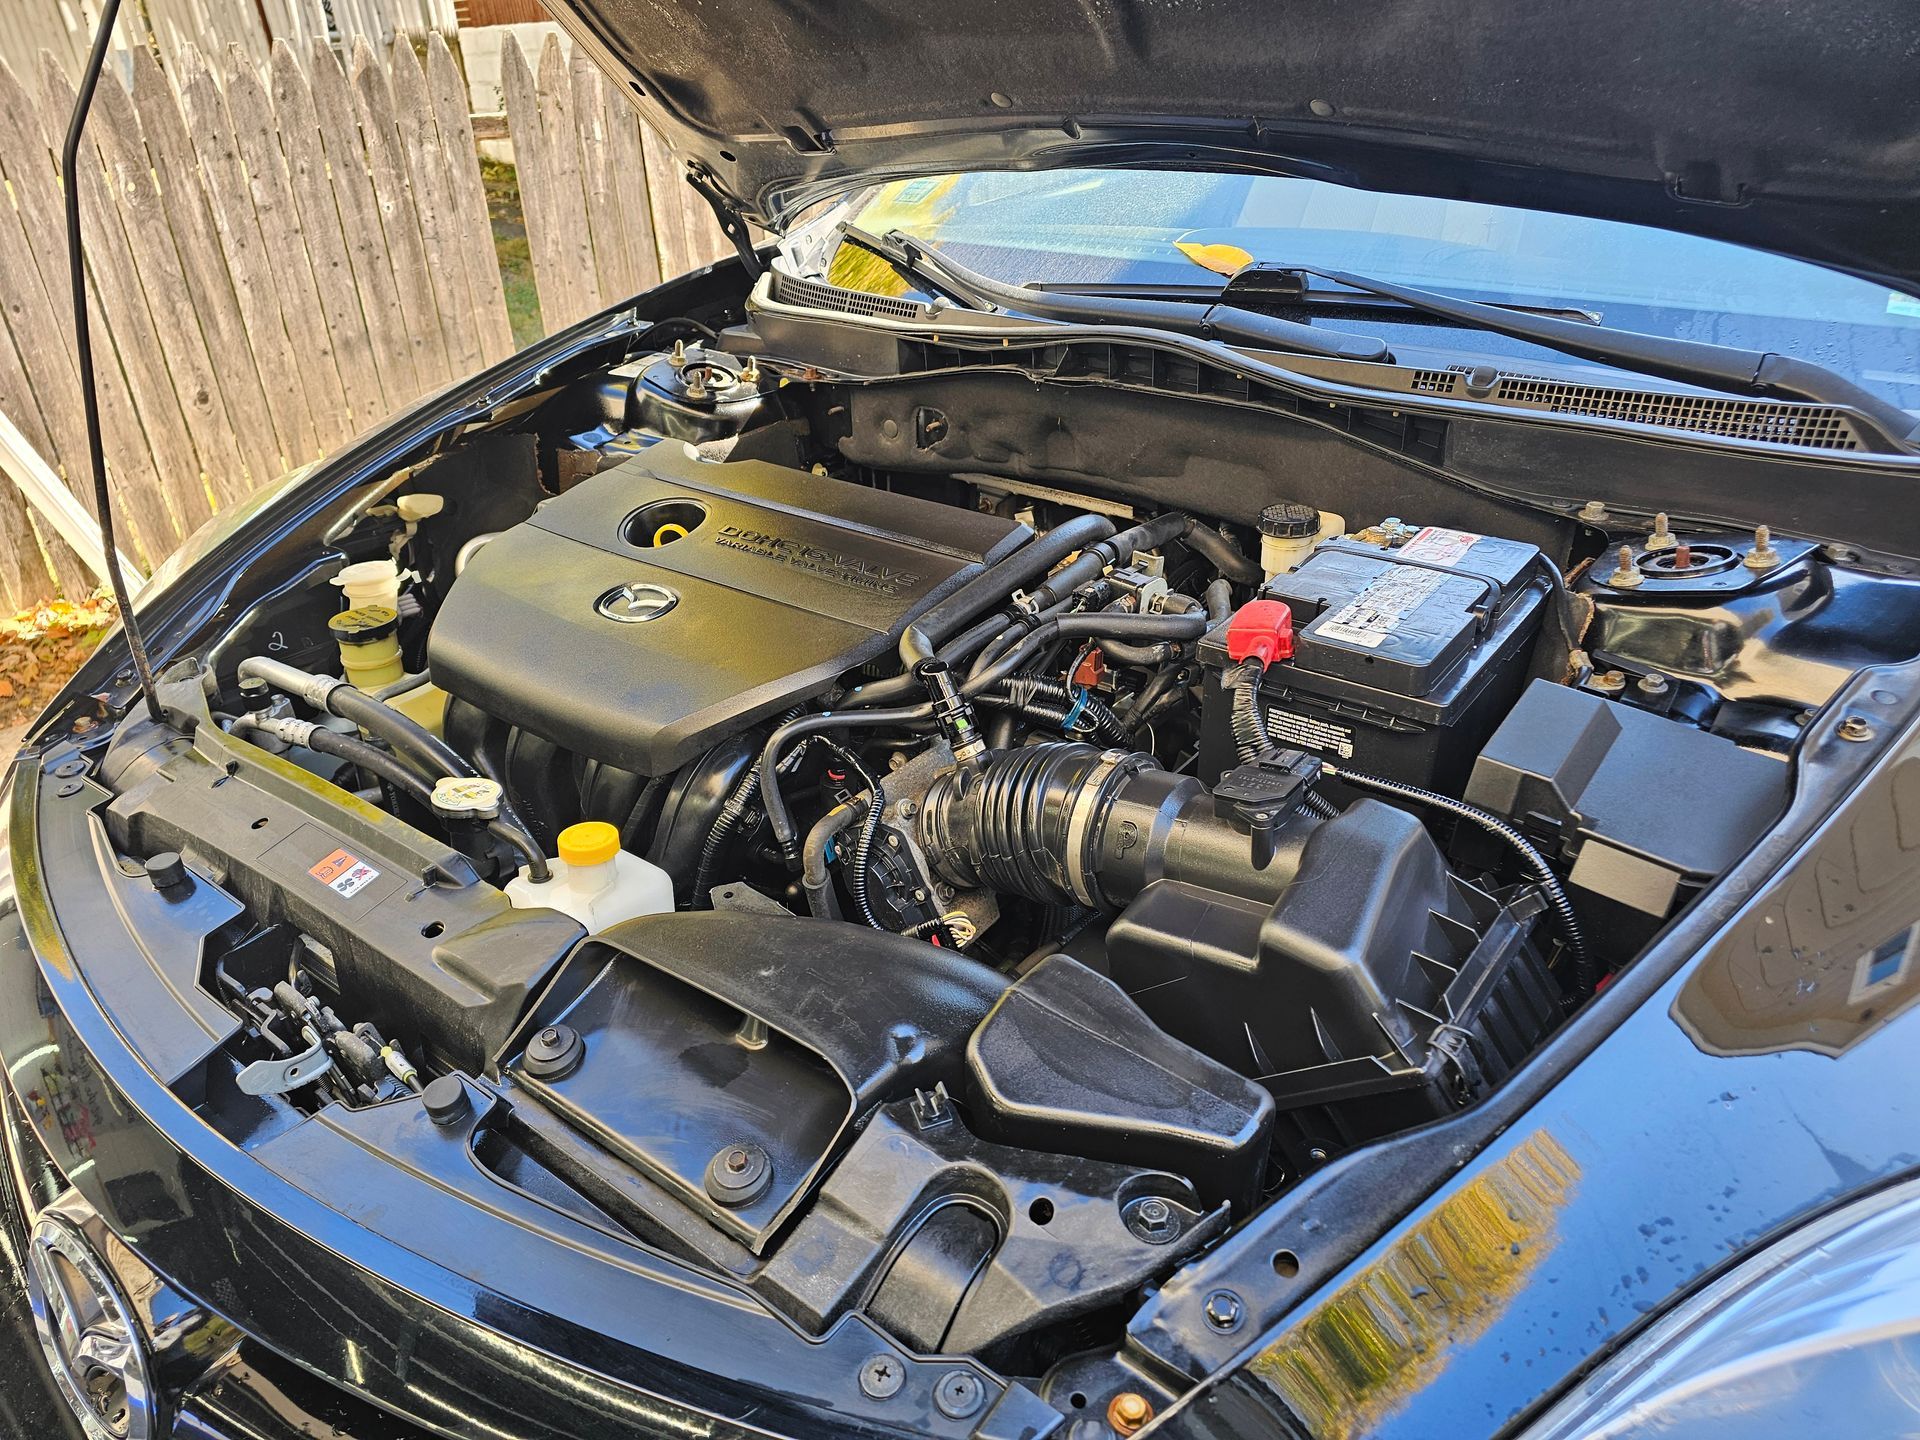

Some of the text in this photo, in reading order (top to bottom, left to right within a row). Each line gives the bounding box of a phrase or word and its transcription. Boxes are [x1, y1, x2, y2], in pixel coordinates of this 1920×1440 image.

[717, 526, 800, 554] DOHC
[714, 536, 788, 563] VARIABLE
[789, 556, 837, 578] VALVE
[267, 630, 289, 651] 2
